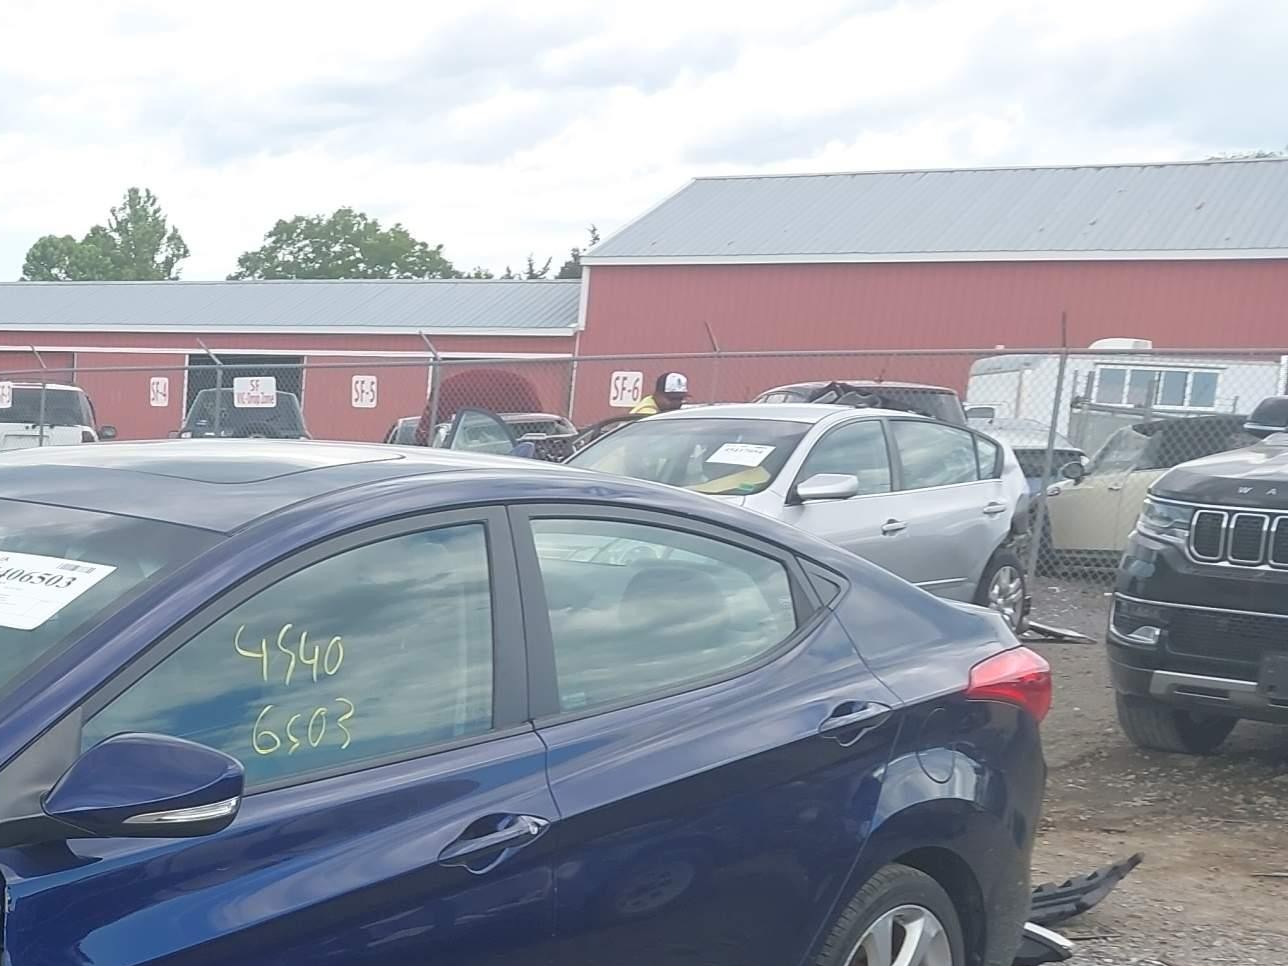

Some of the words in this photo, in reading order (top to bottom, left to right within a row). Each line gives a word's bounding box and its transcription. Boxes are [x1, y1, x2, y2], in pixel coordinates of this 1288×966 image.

[249, 379, 260, 392] SF
[354, 380, 375, 403] SF-5
[612, 375, 640, 402] SF-6
[235, 624, 344, 685] 4540
[253, 698, 355, 755] 6503
